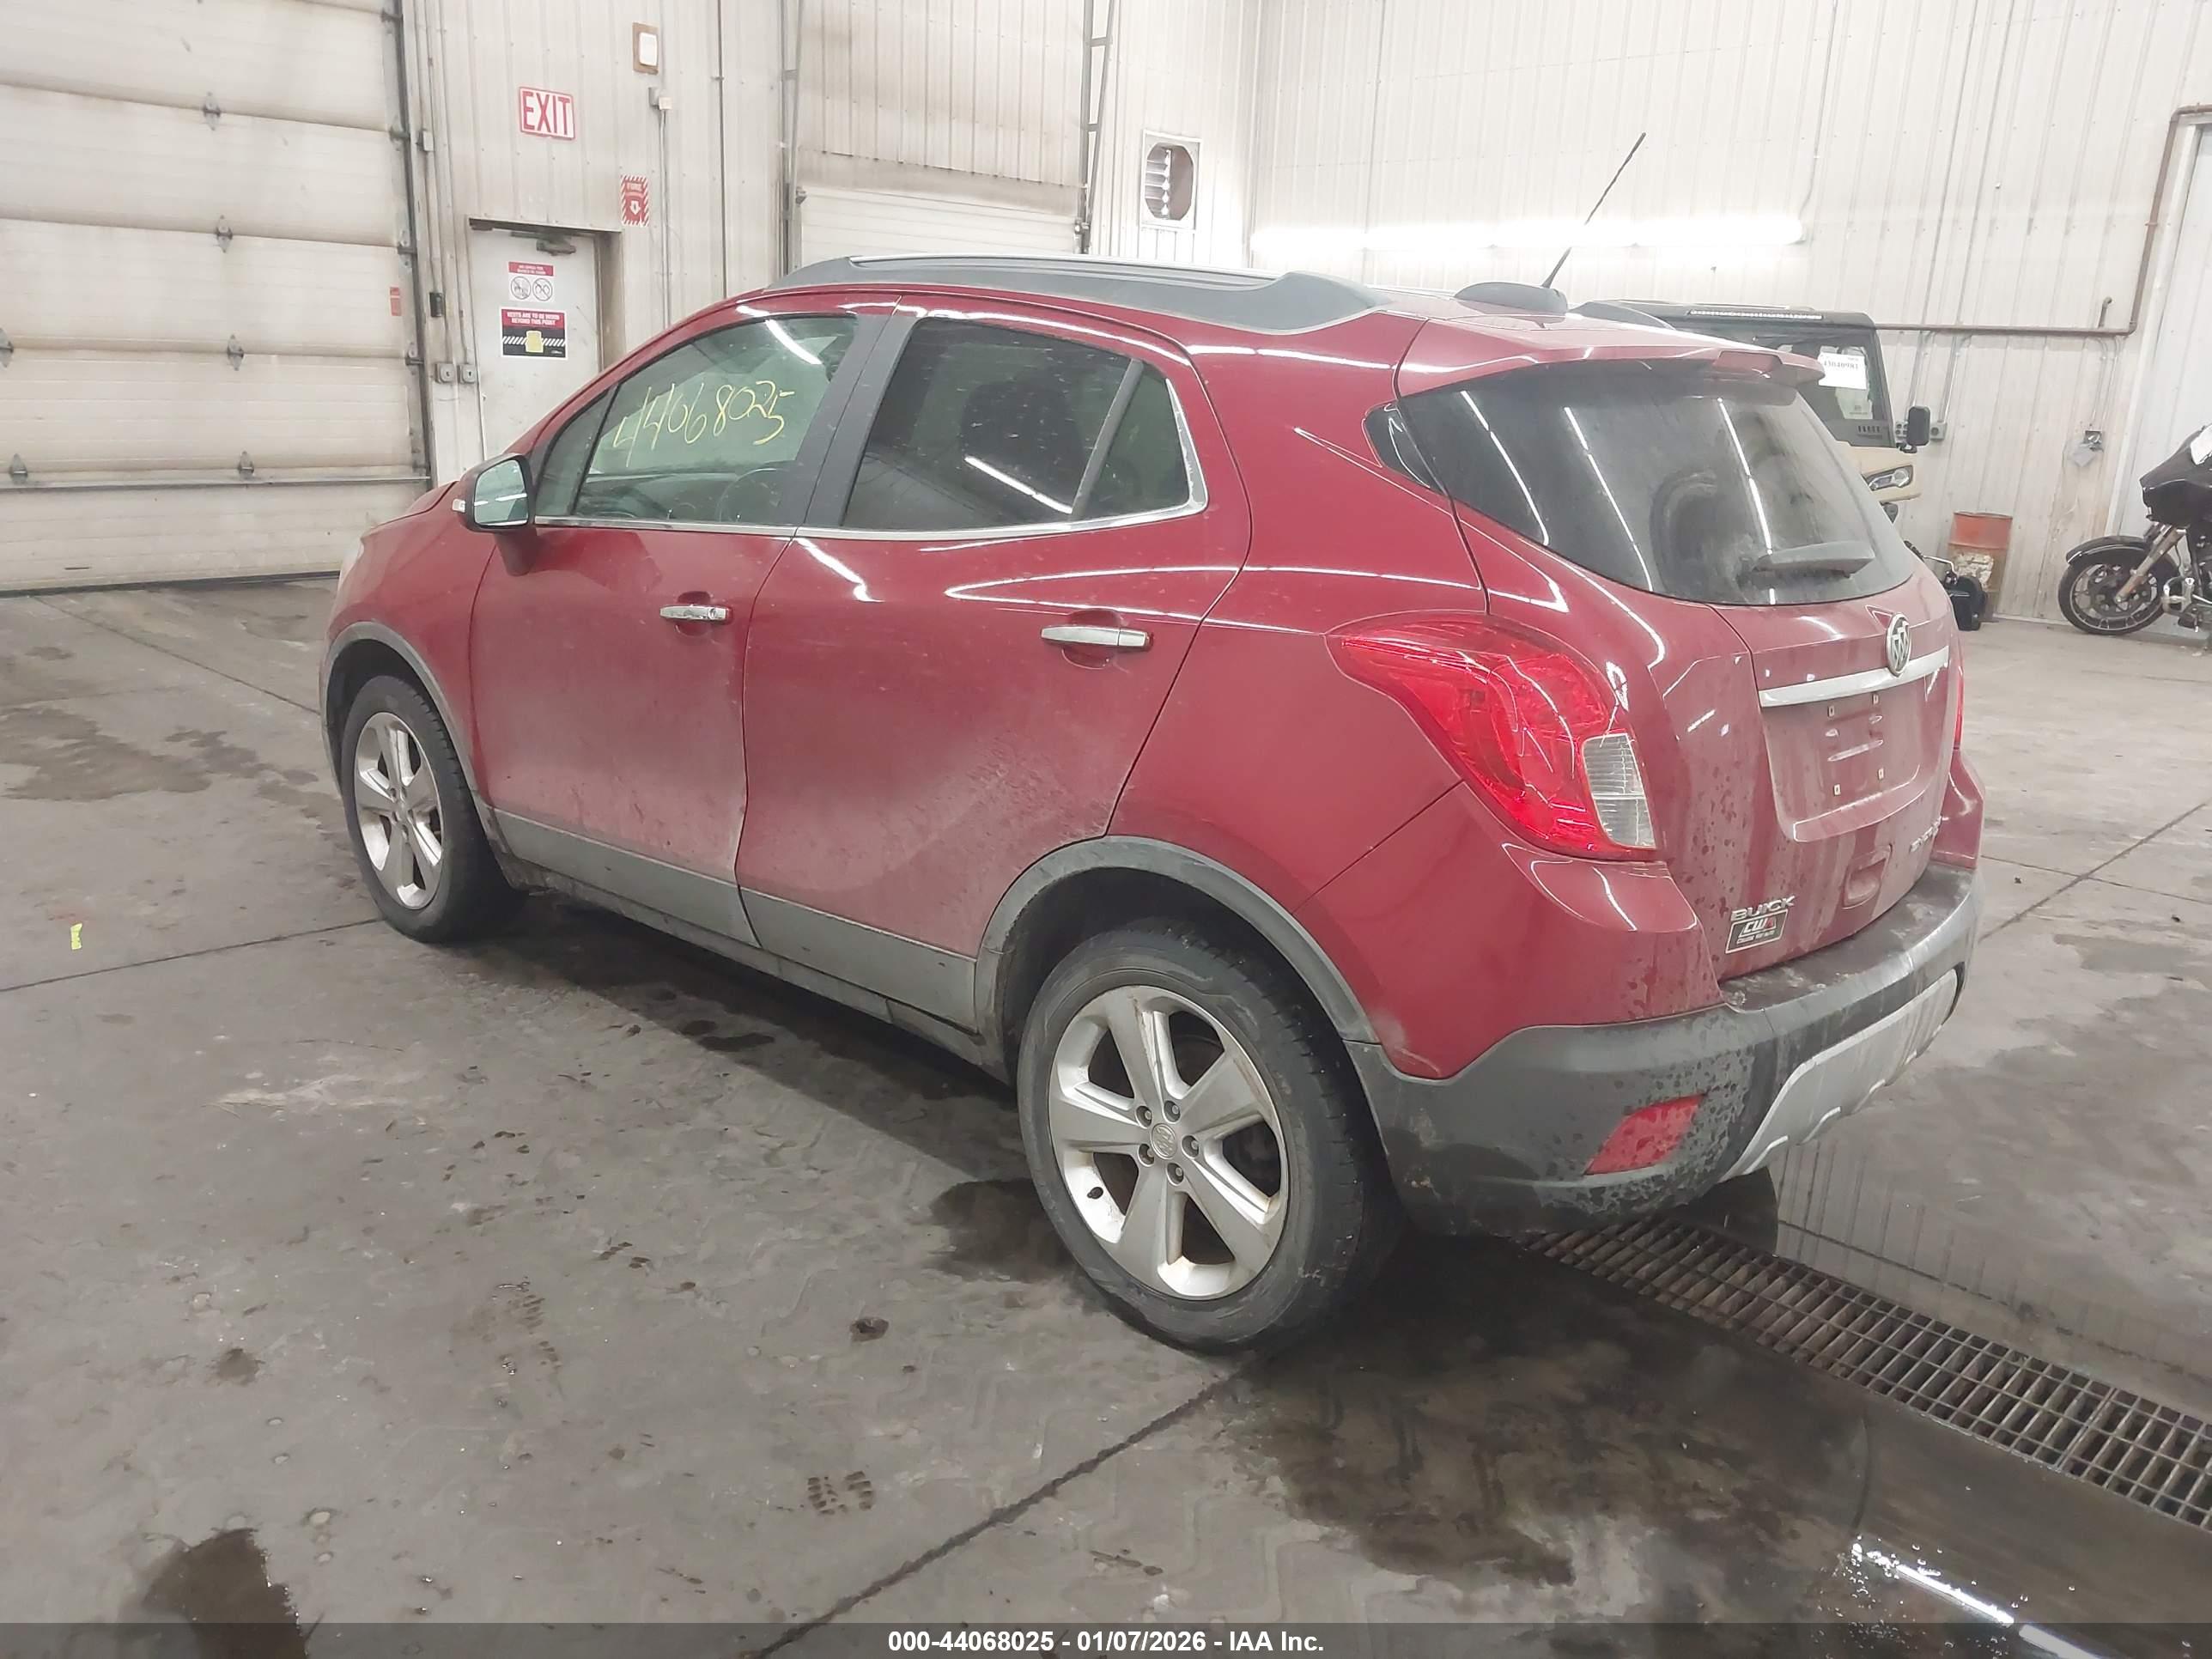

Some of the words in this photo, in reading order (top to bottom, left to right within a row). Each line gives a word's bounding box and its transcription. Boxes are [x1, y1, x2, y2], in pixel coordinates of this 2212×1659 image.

[521, 90, 571, 136] EXIT
[613, 380, 795, 467] 44068025
[1730, 896, 1796, 921] BUICK
